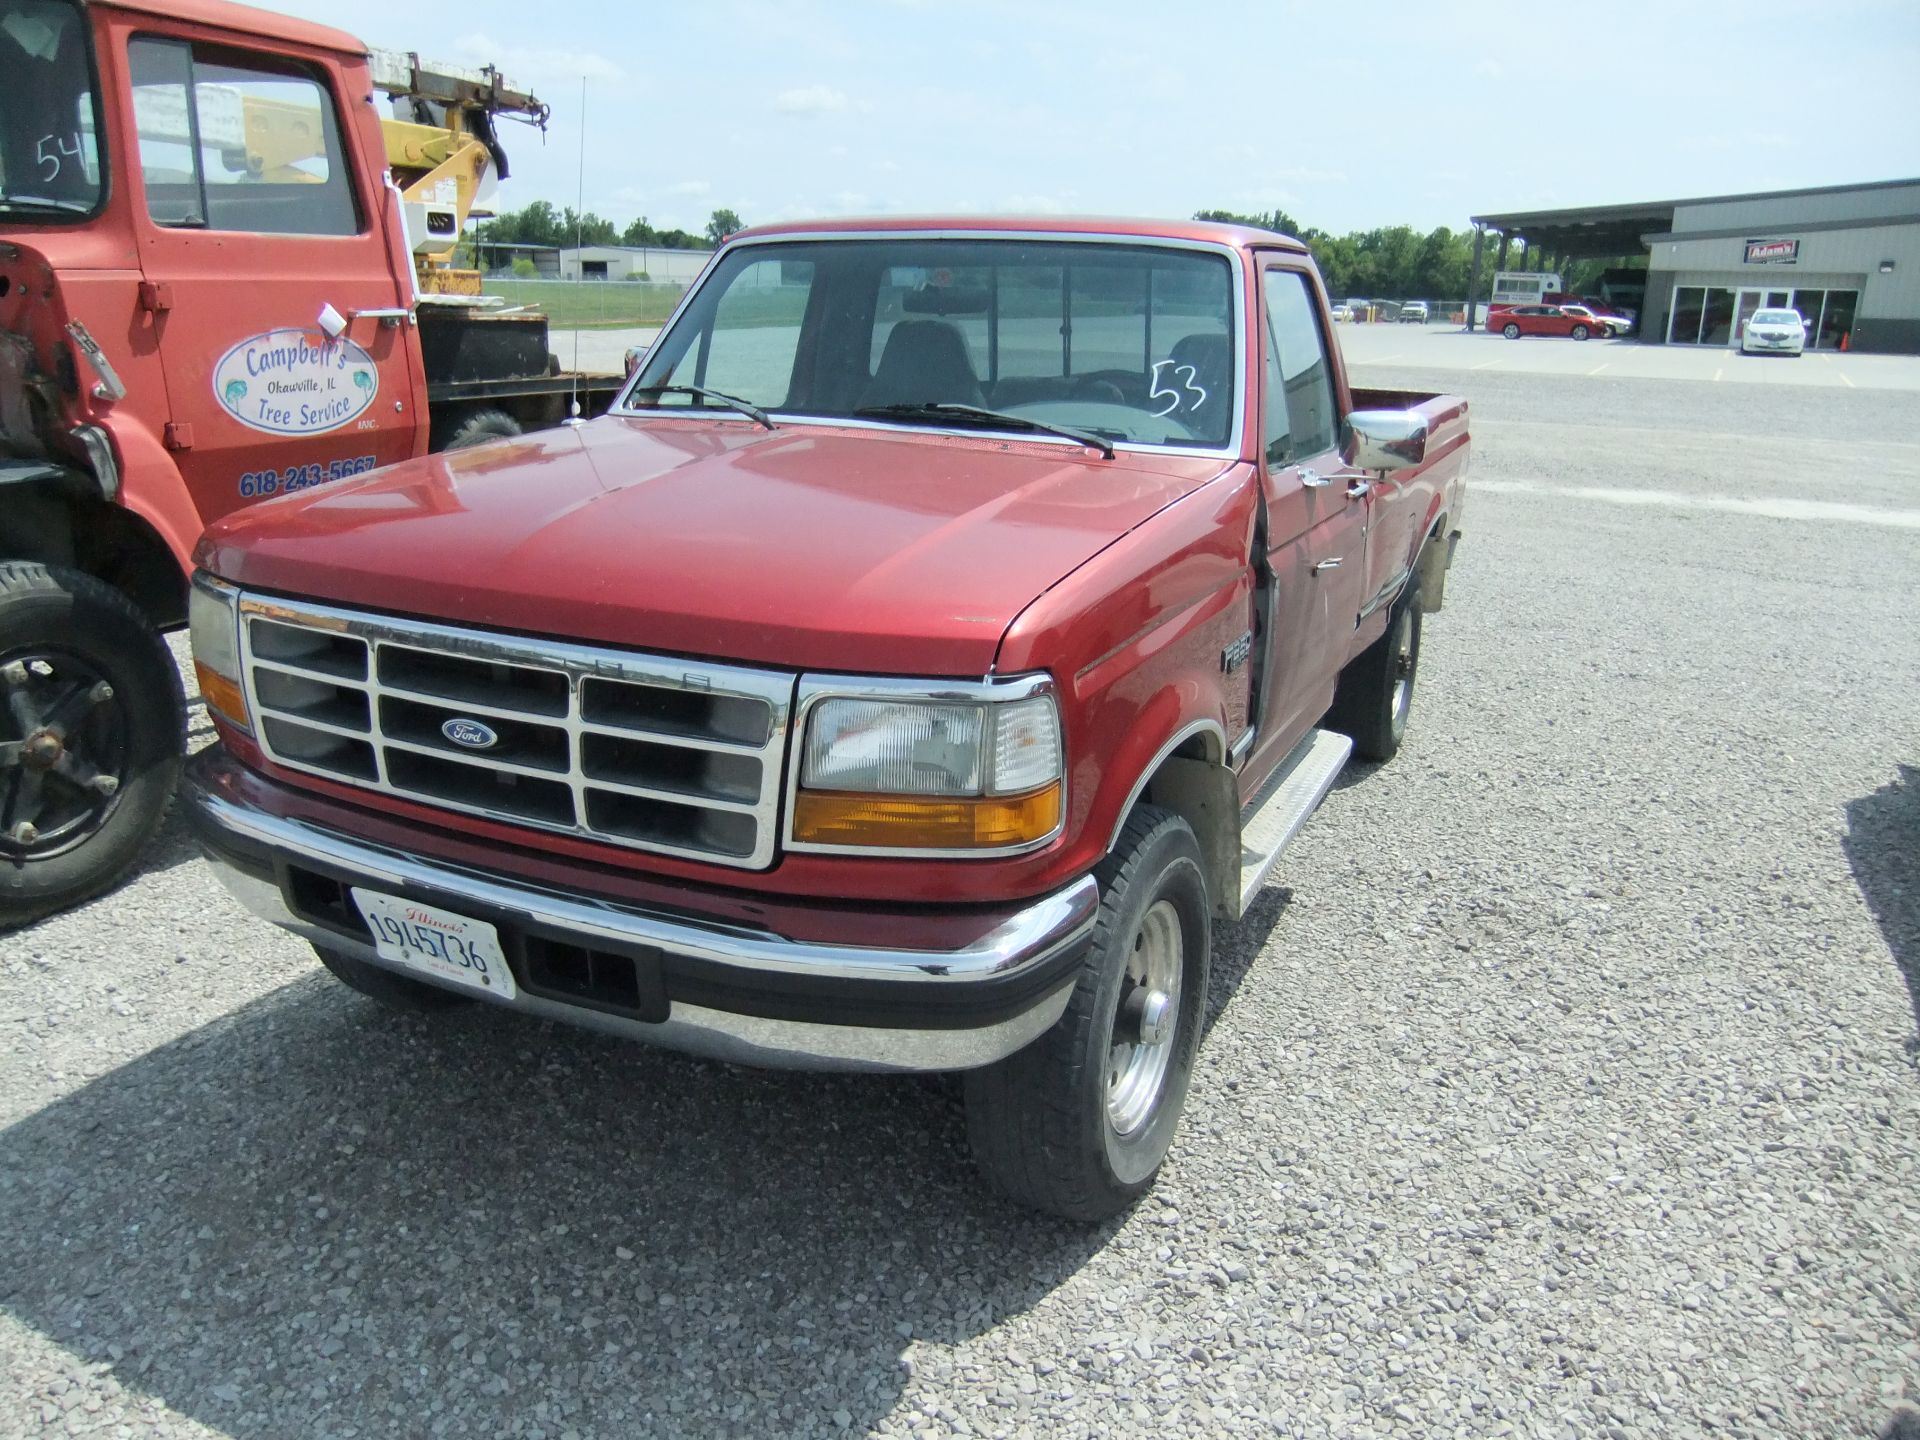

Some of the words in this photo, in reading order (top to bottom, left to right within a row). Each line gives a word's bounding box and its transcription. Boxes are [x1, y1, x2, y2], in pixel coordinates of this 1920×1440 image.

[37, 131, 89, 182] 54
[246, 336, 347, 377] Campbell's
[327, 377, 337, 390] IL
[1149, 359, 1207, 418] 53
[258, 398, 292, 425] Tree
[300, 396, 351, 426] Service
[238, 455, 377, 497] 618-243-5667
[453, 724, 482, 743] Ford
[405, 907, 465, 934] Illinois
[369, 912, 488, 974] 1945736
